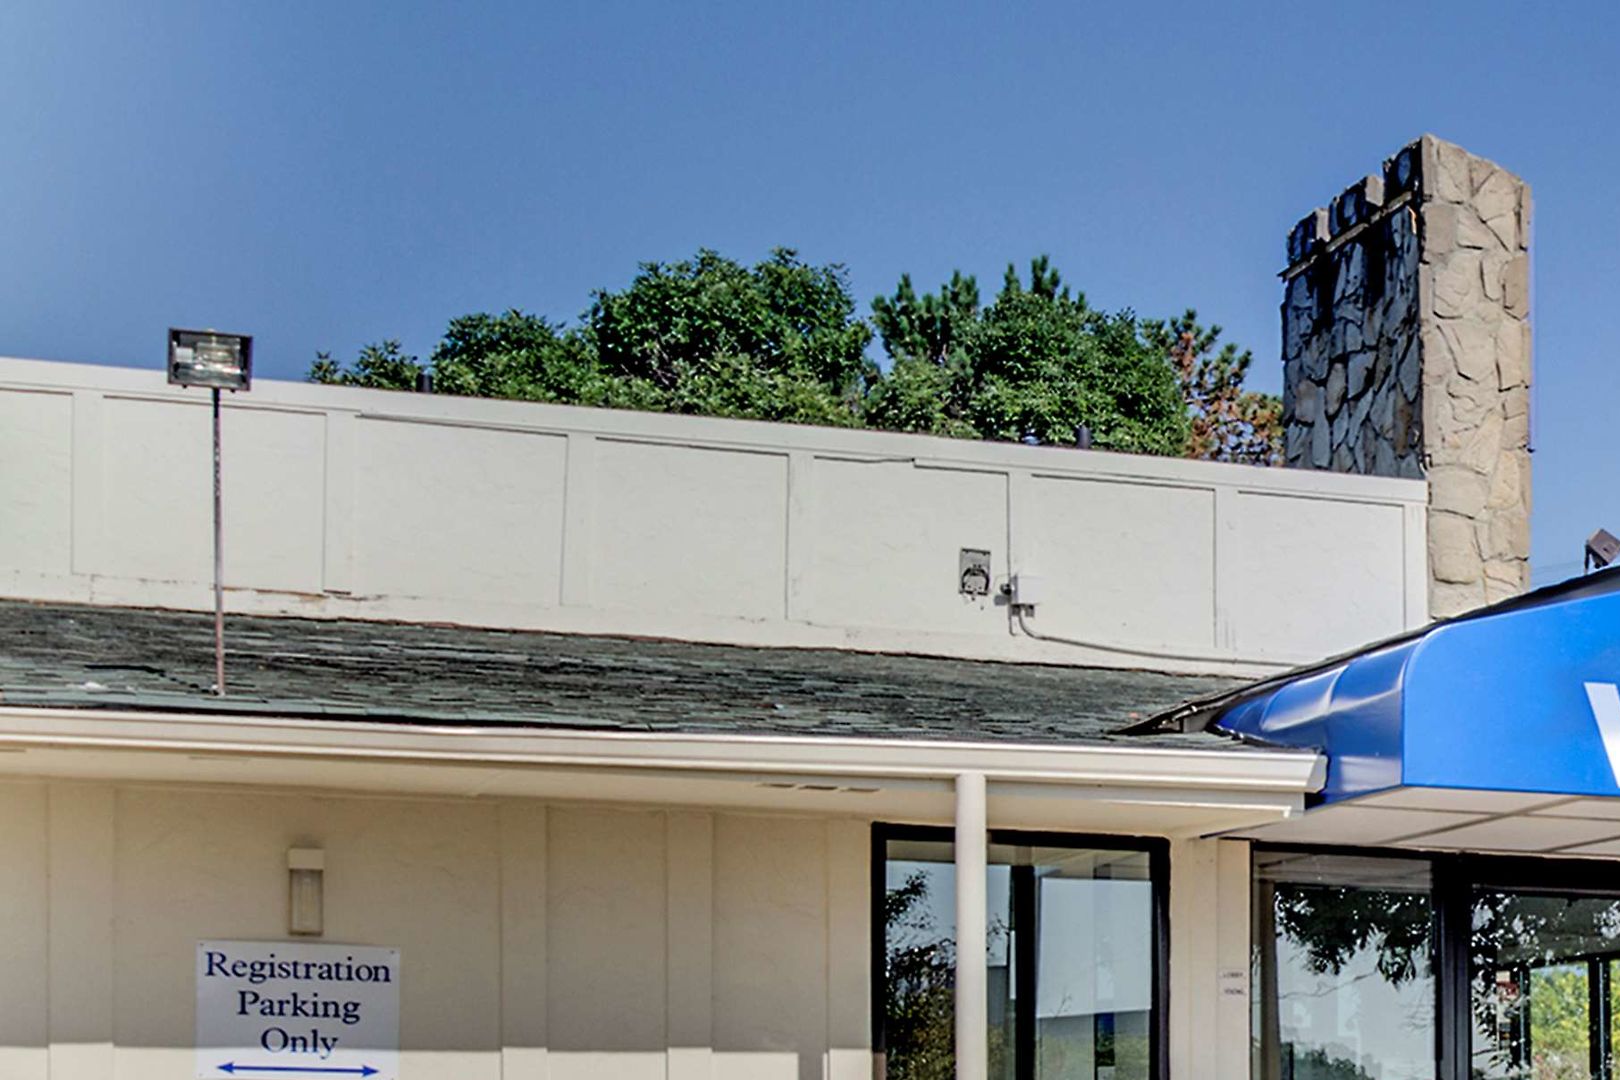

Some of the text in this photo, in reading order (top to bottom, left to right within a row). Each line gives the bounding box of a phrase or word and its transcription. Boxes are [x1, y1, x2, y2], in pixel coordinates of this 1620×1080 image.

[205, 951, 391, 985] Registration
[237, 990, 361, 1025] Parking
[261, 1027, 339, 1060] Only
